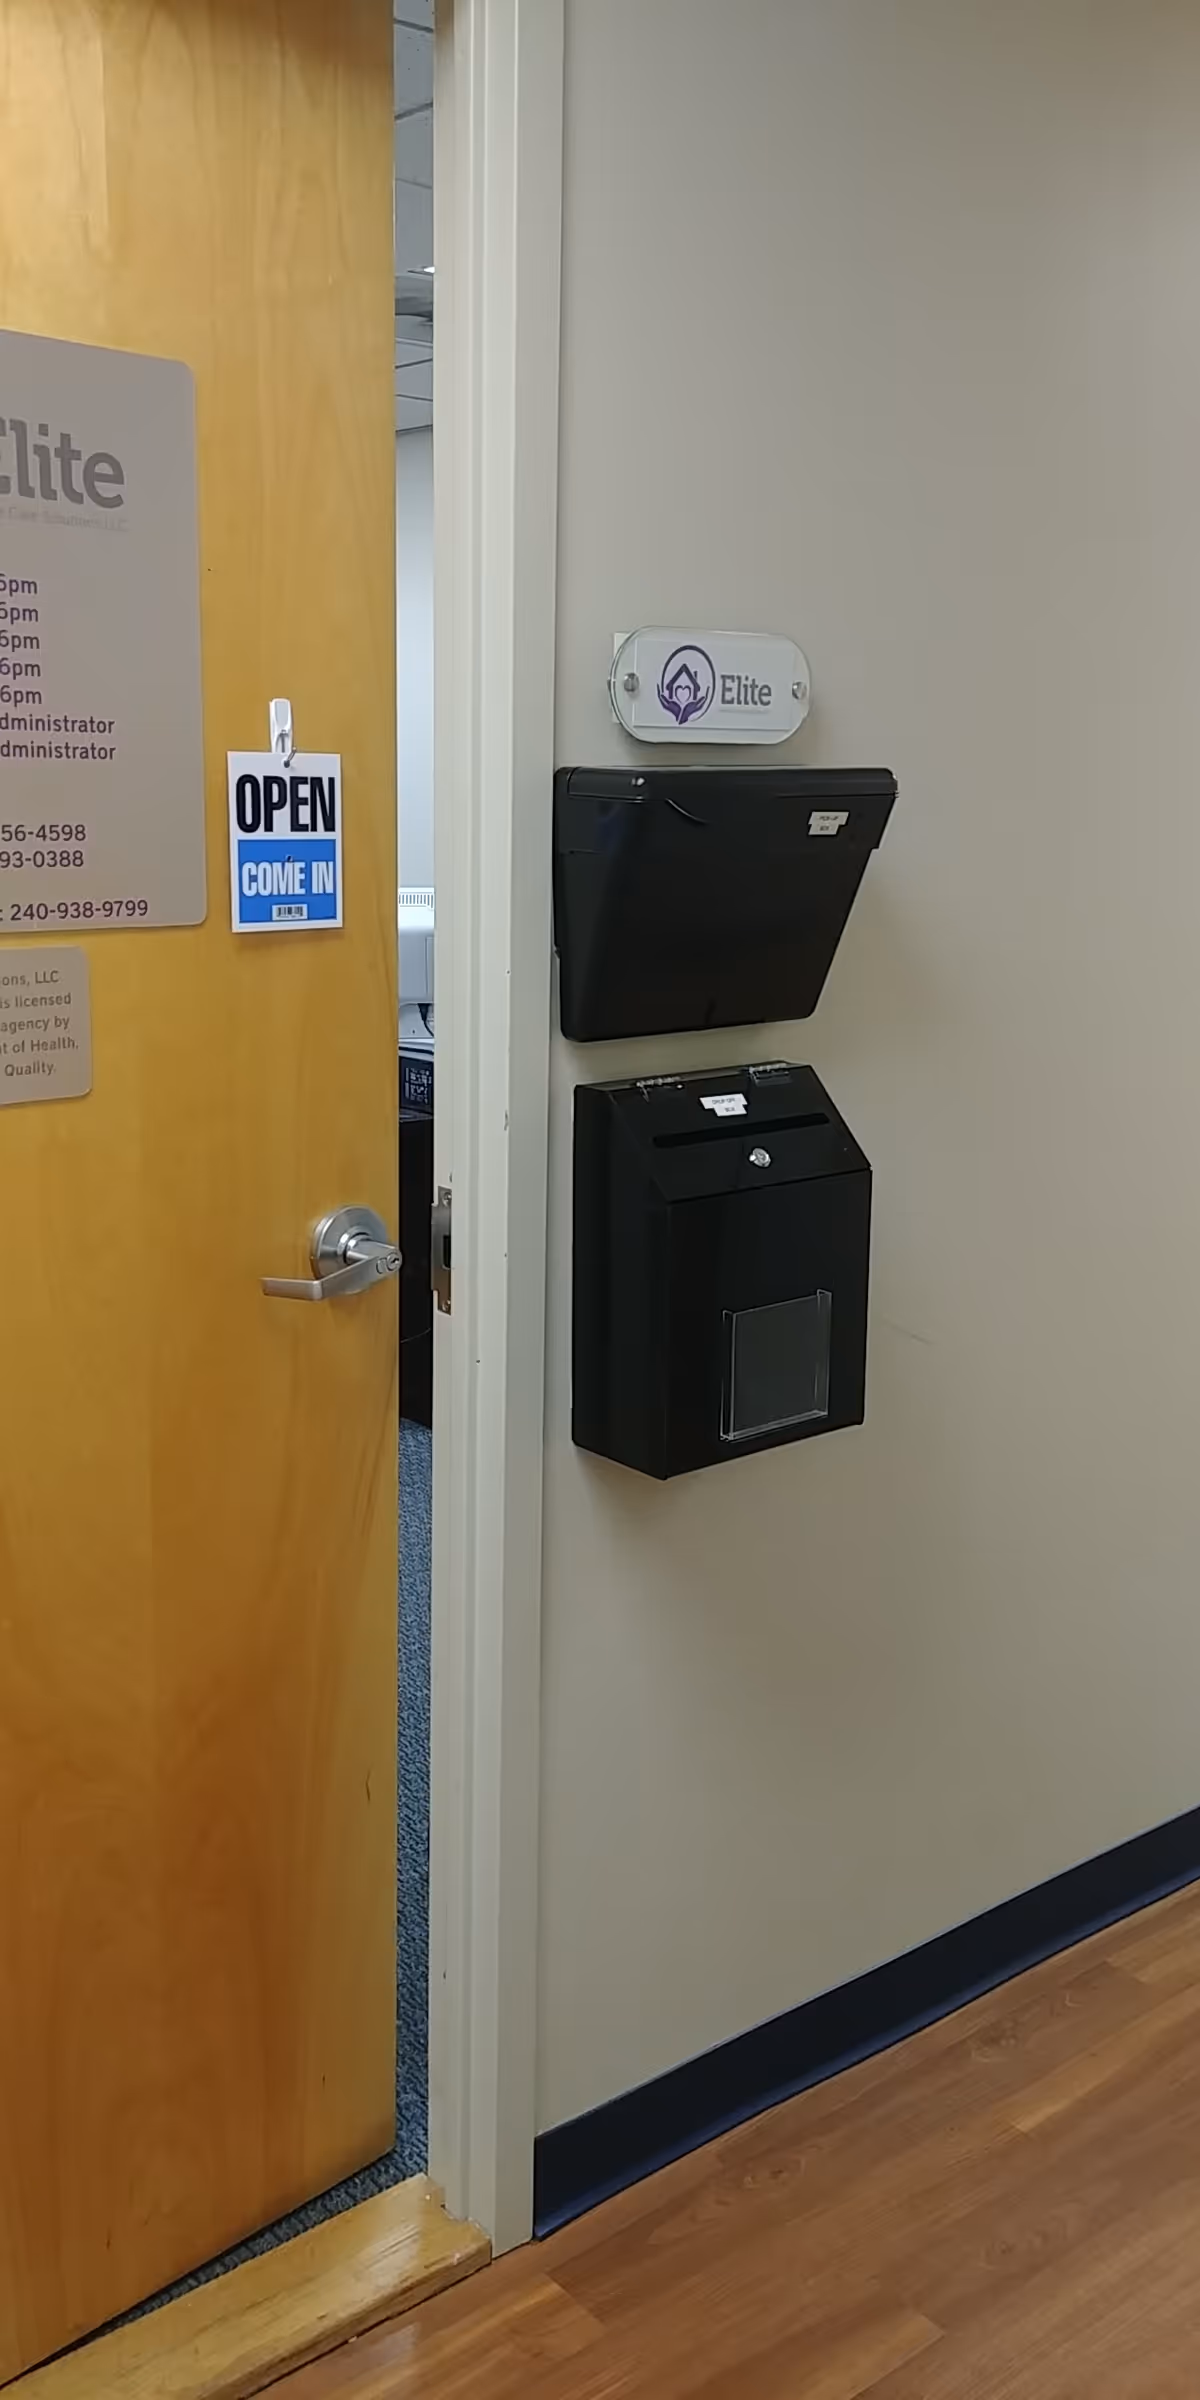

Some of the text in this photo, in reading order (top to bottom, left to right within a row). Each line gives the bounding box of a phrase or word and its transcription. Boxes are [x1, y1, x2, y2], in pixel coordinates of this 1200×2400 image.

[0, 416, 125, 509] lite
[0, 657, 41, 680] 6pm
[0, 685, 42, 708] 6pm
[720, 674, 772, 706] Elite
[0, 739, 117, 760] dministrator
[235, 773, 336, 834] OPEN
[1, 823, 87, 842] 56-4598
[0, 850, 84, 868] 93-0388
[241, 860, 334, 897] COME IN
[10, 899, 148, 921] 240-938-9799
[34, 969, 60, 984] LLC
[15, 992, 72, 1008] licensed
[0, 1015, 70, 1035] agency by
[12, 1039, 25, 1054] of
